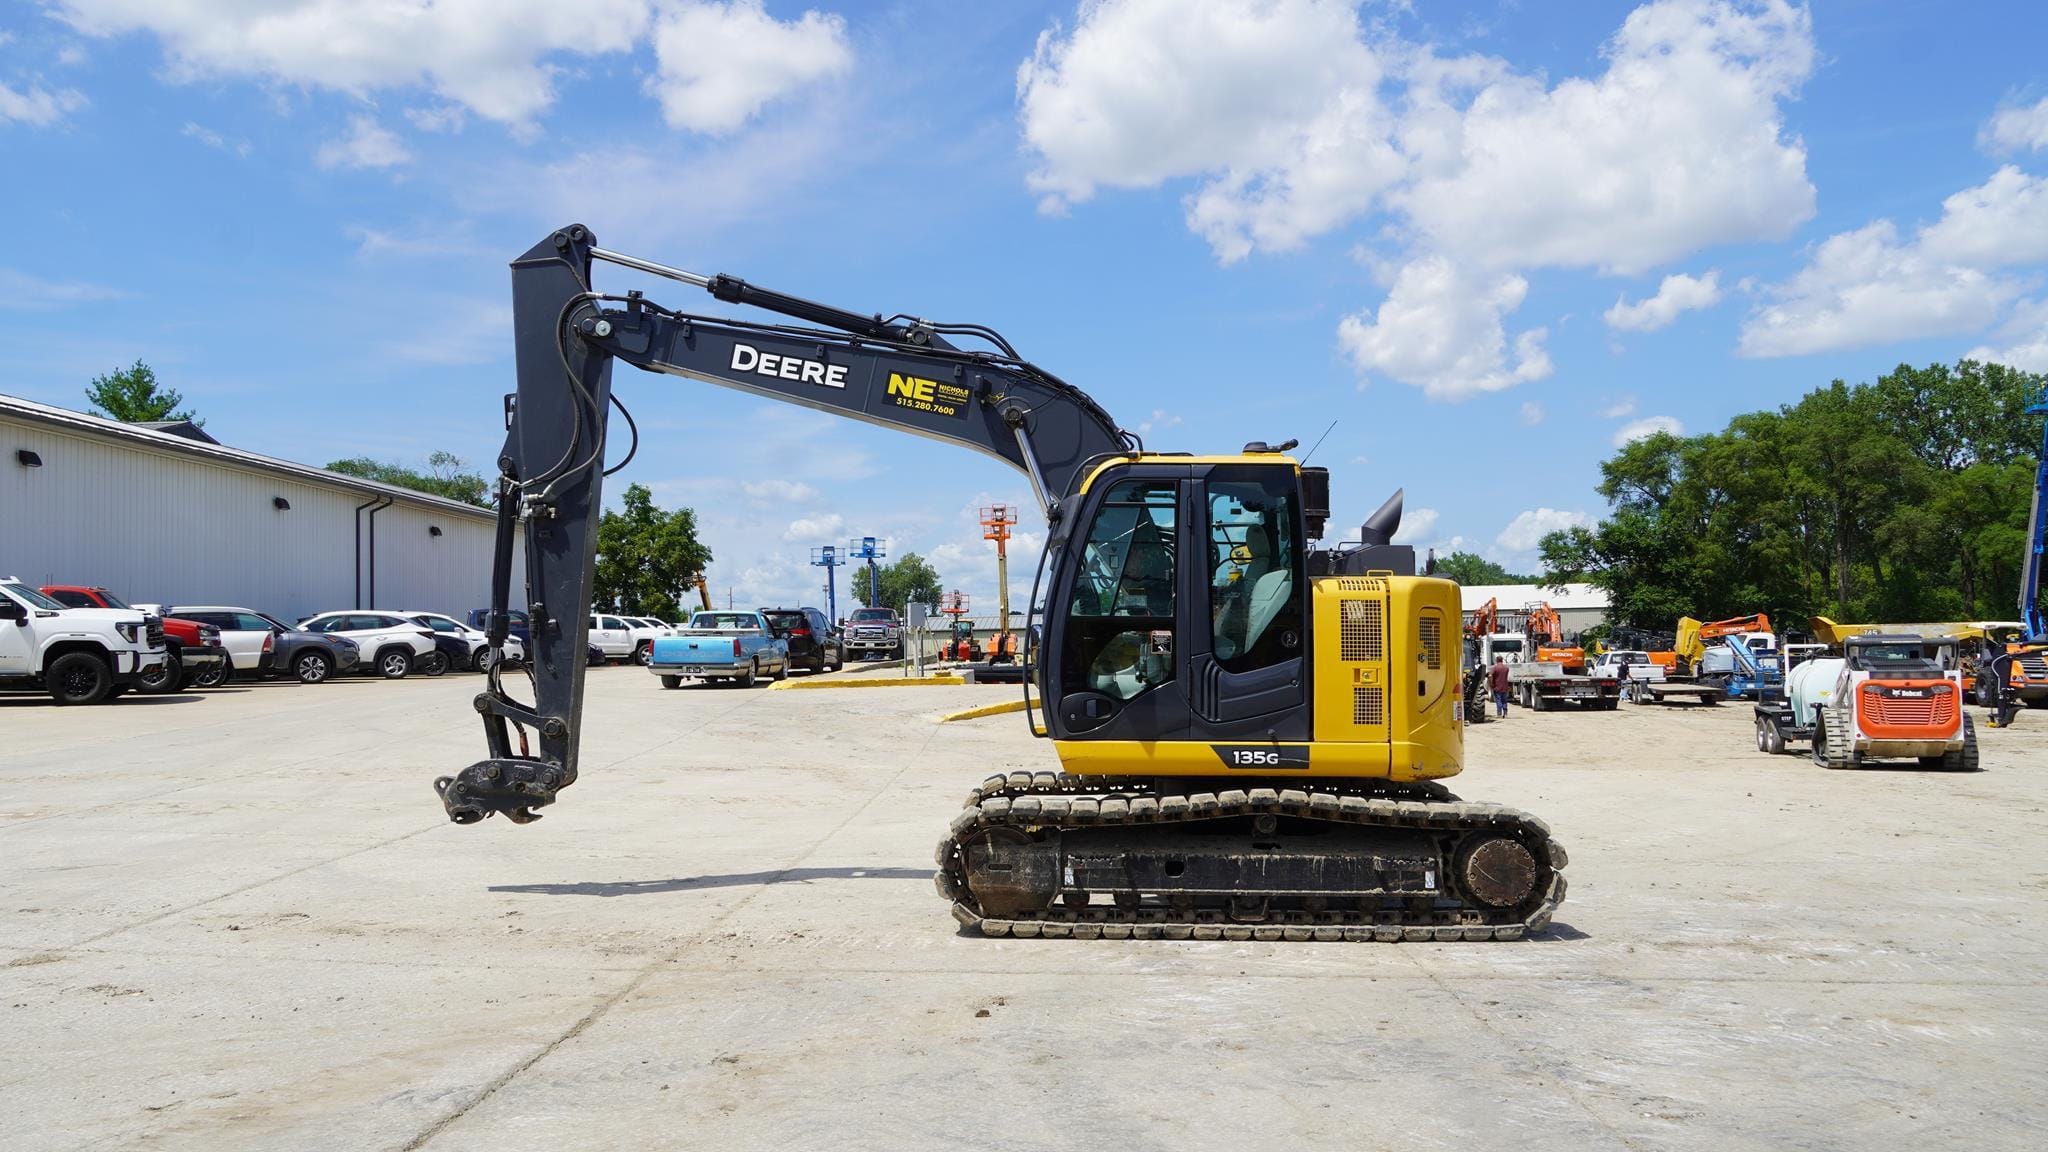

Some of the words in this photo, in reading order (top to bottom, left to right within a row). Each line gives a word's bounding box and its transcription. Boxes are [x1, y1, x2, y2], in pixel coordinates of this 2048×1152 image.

[731, 344, 848, 388] DEERE
[887, 373, 937, 402] NE
[938, 384, 969, 395] NICHOLS
[896, 397, 955, 416] 515.280.7600
[1233, 750, 1279, 765] 135G
